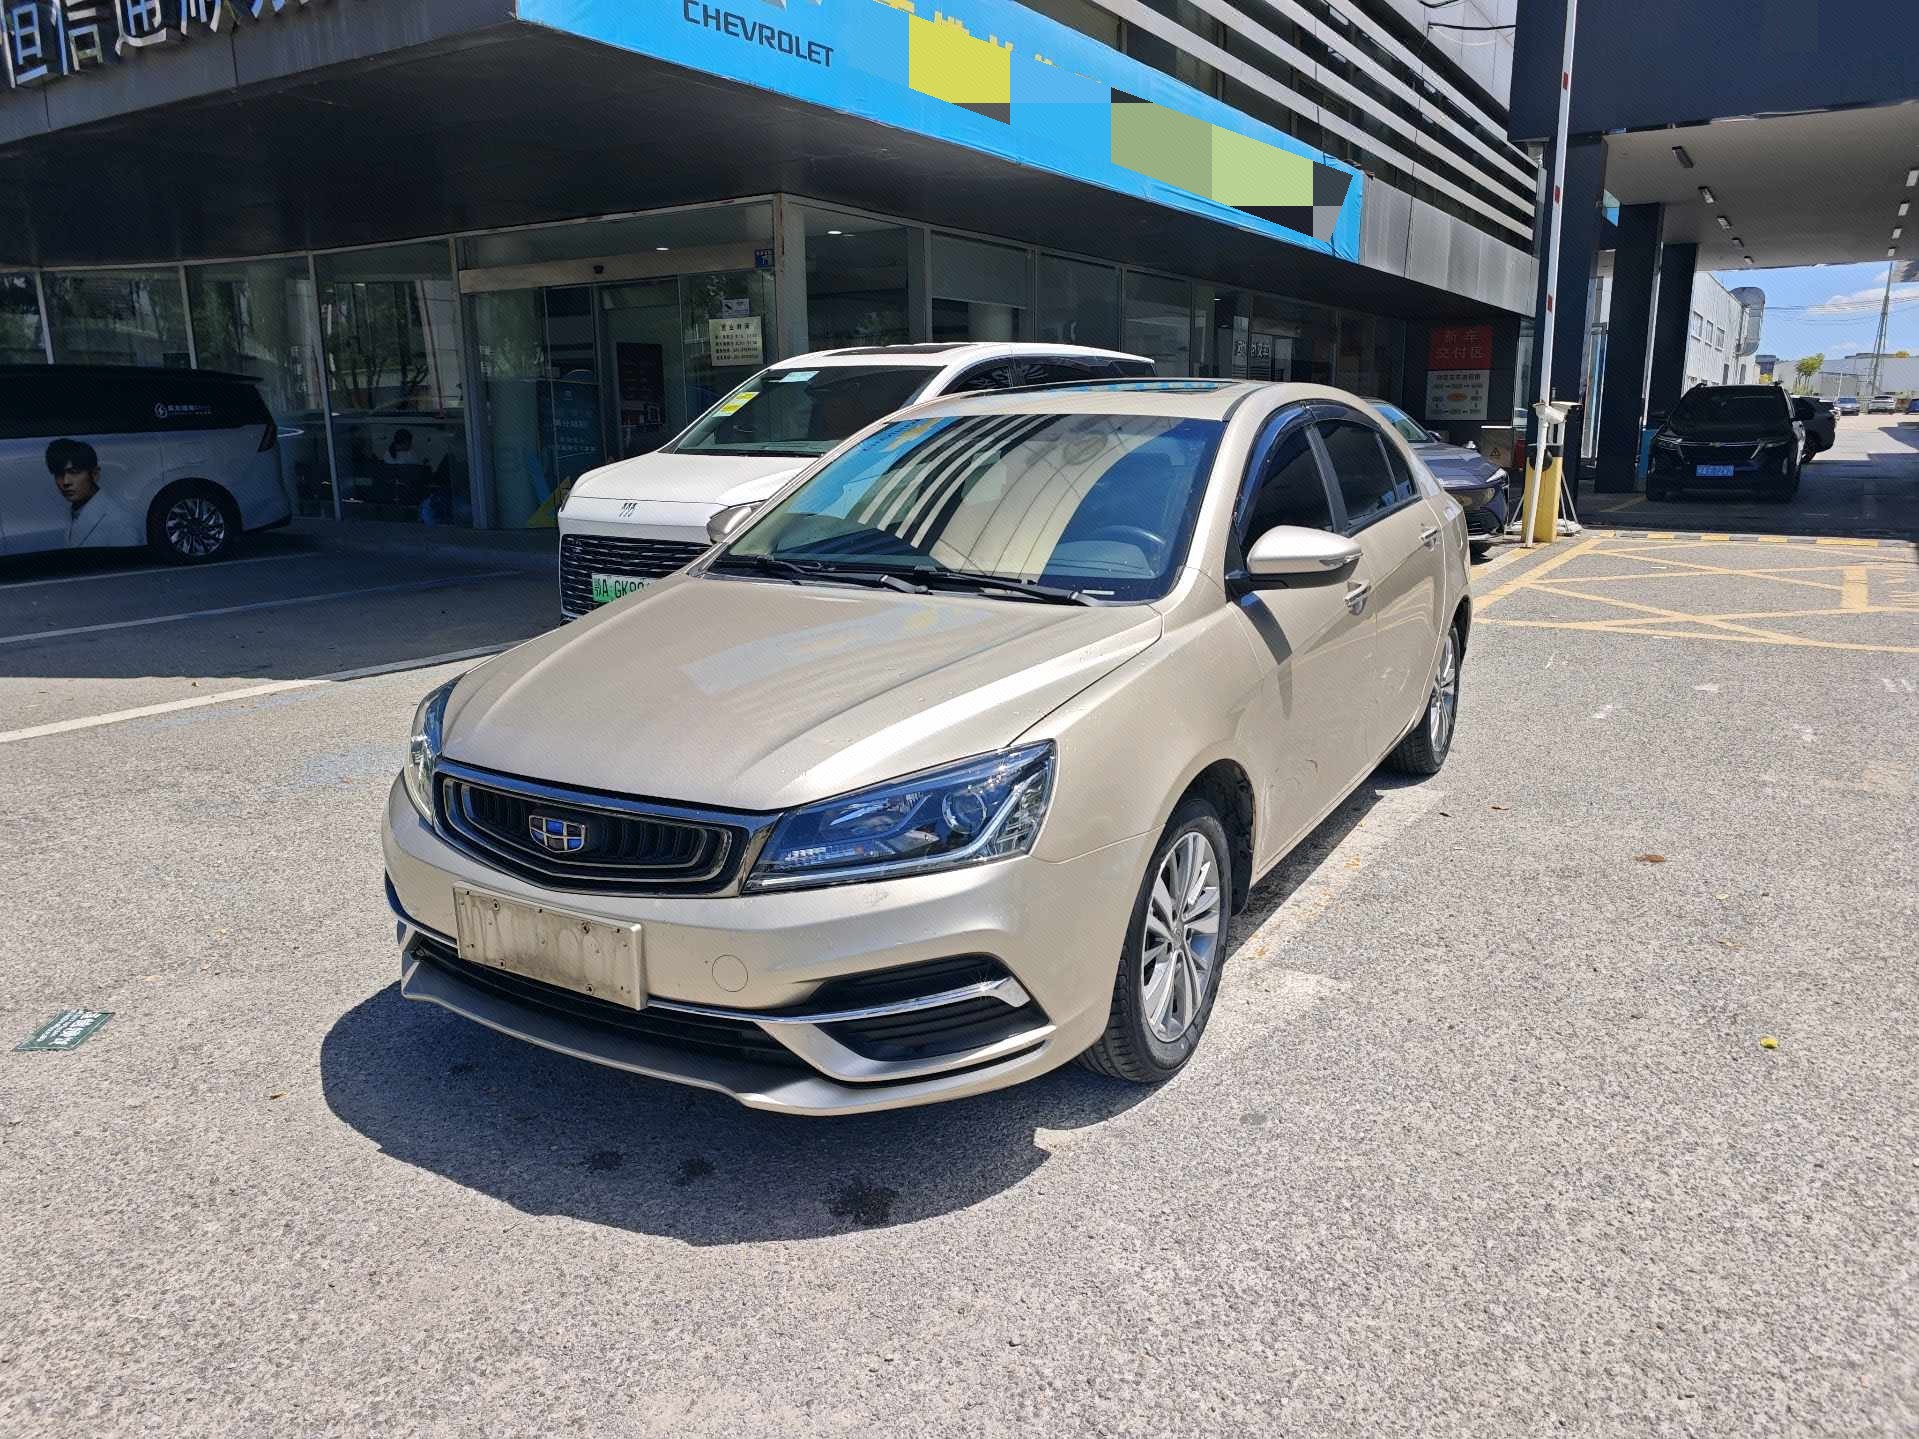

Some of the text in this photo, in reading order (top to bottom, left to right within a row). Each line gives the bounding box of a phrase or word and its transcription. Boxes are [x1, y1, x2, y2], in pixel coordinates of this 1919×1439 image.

[684, 0, 834, 67] CHEVROLET
[1437, 346, 1484, 359] 交付区
